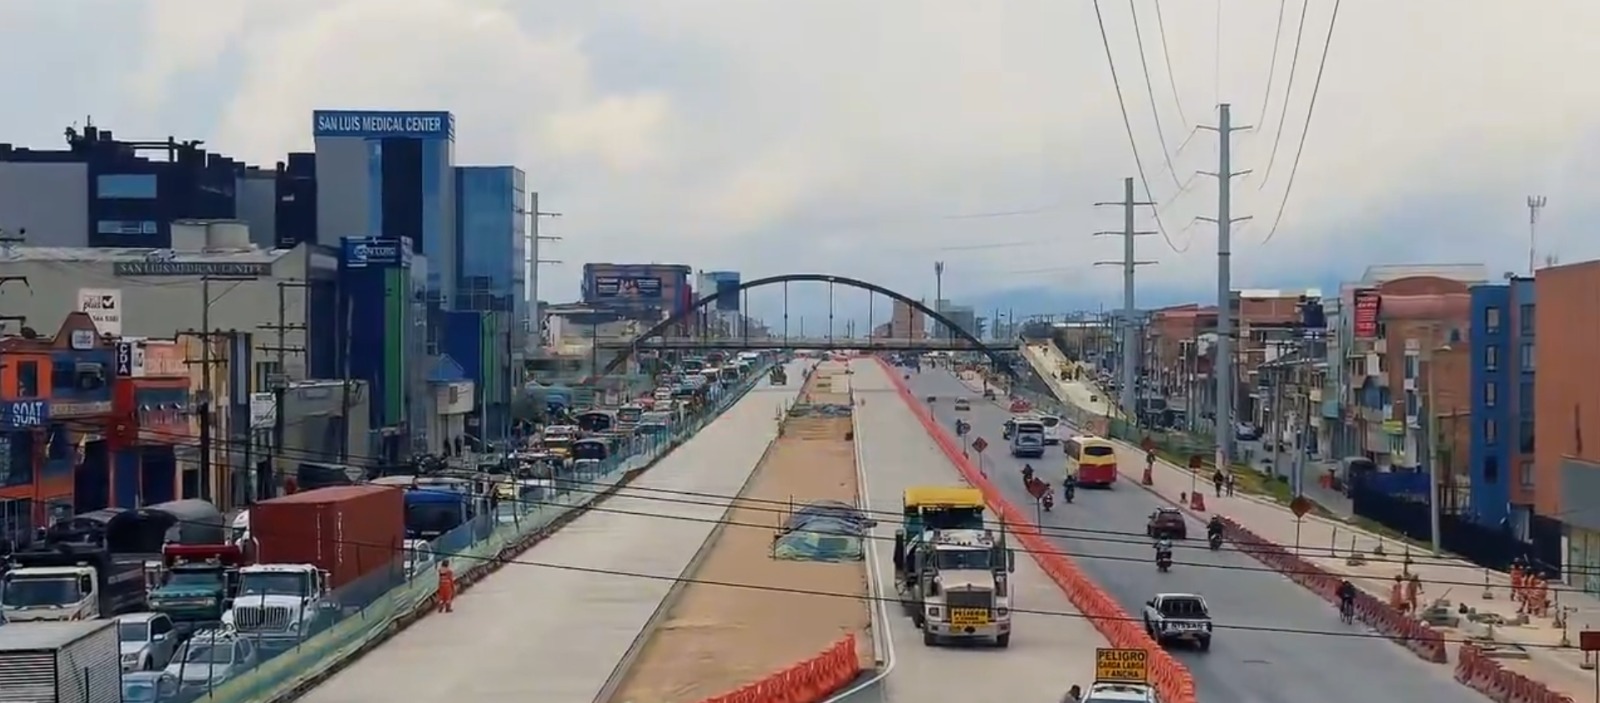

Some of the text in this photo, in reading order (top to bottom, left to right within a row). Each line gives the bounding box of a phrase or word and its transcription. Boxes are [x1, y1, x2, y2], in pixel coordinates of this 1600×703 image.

[318, 116, 338, 131] SAN
[339, 116, 361, 131] LUIS
[362, 117, 404, 131] MEDICAL
[405, 117, 441, 131] CENTER
[119, 263, 142, 273] SAN
[144, 263, 170, 273] LUIS
[171, 263, 220, 273] MEDICAL
[119, 344, 129, 374] CDA
[12, 402, 43, 426] SOAT
[1098, 651, 1145, 661] PELIGRO
[1111, 669, 1139, 677] ANCHA
